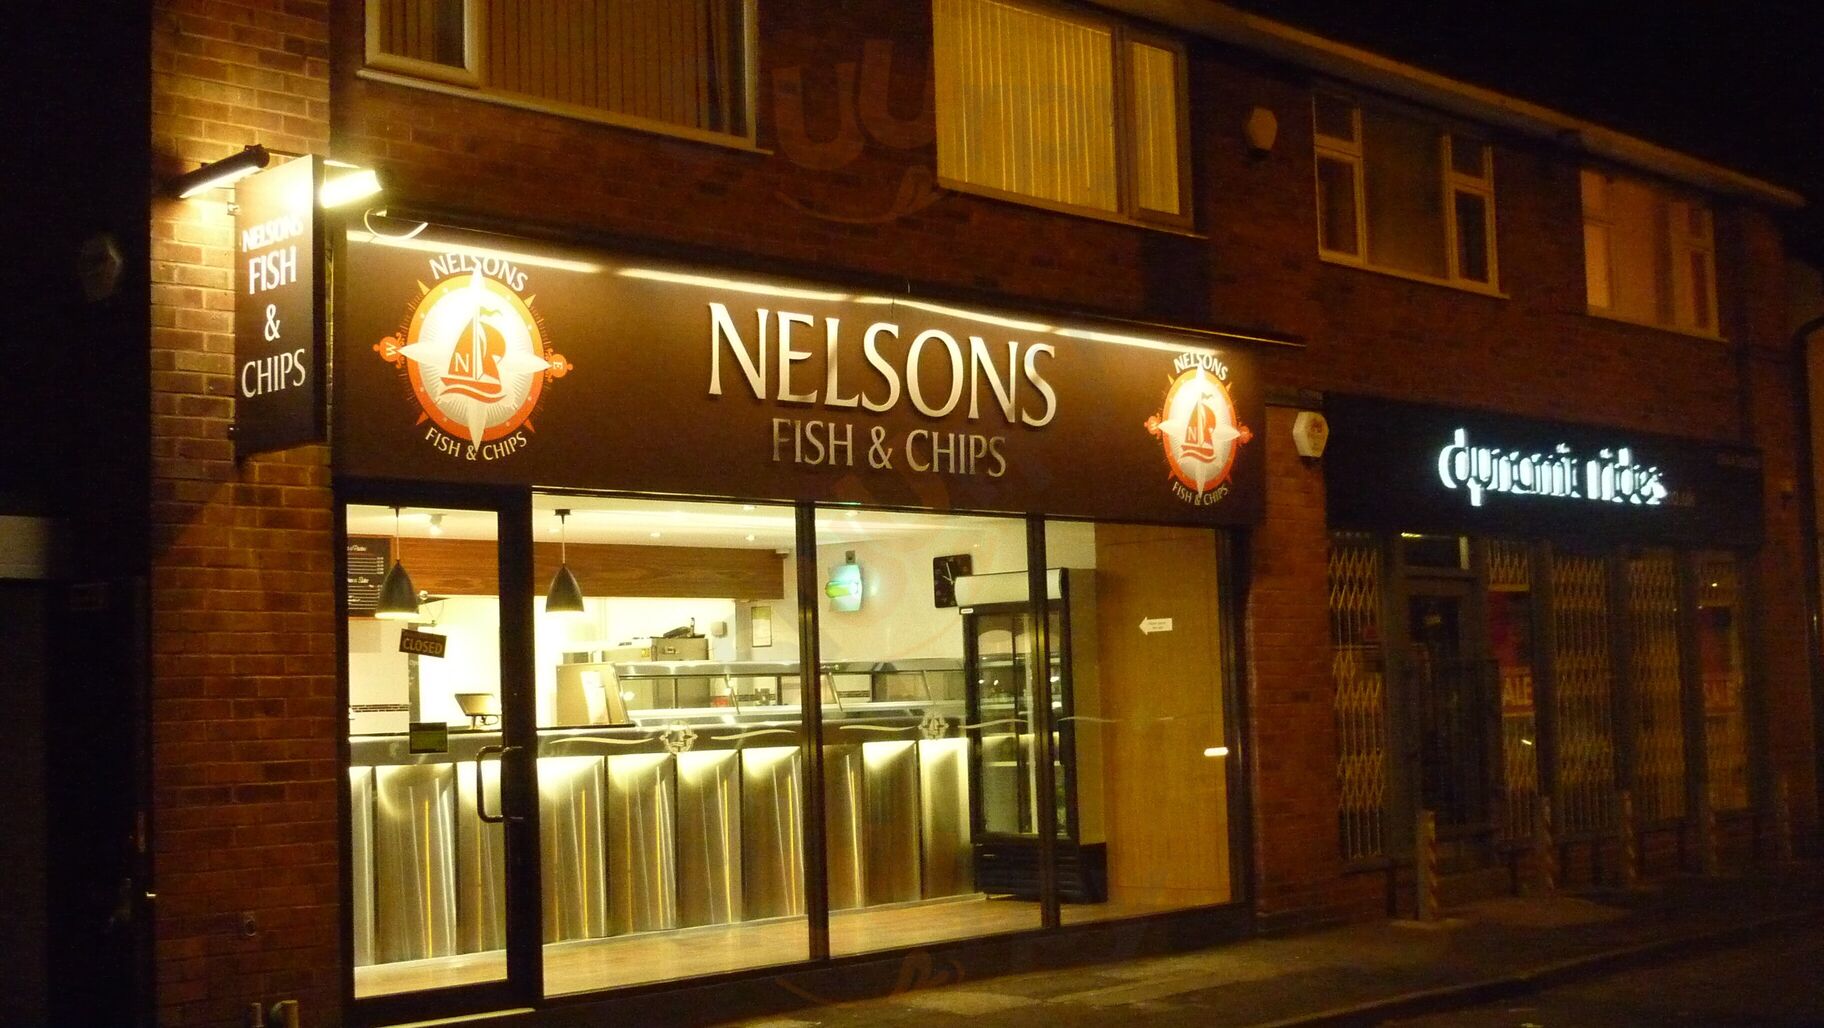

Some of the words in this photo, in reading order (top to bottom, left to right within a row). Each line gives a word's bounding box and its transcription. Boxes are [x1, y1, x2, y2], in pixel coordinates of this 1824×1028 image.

[241, 214, 304, 253] NELSONS
[248, 245, 297, 296] FISH
[428, 252, 529, 293] NELSONS
[264, 303, 281, 342] &
[241, 348, 306, 398] CHIPS
[708, 302, 1057, 428] NELSONS
[1173, 352, 1229, 382] NELSONS
[424, 426, 461, 459] FISH
[465, 445, 478, 462] &
[482, 430, 528, 461] CHIPS
[772, 418, 854, 467] FISH
[867, 425, 894, 470] &
[905, 429, 1007, 478] CHIPS
[1172, 481, 1193, 503] FISH
[1203, 484, 1229, 506] CHIPS
[402, 637, 443, 655] CLOSED
